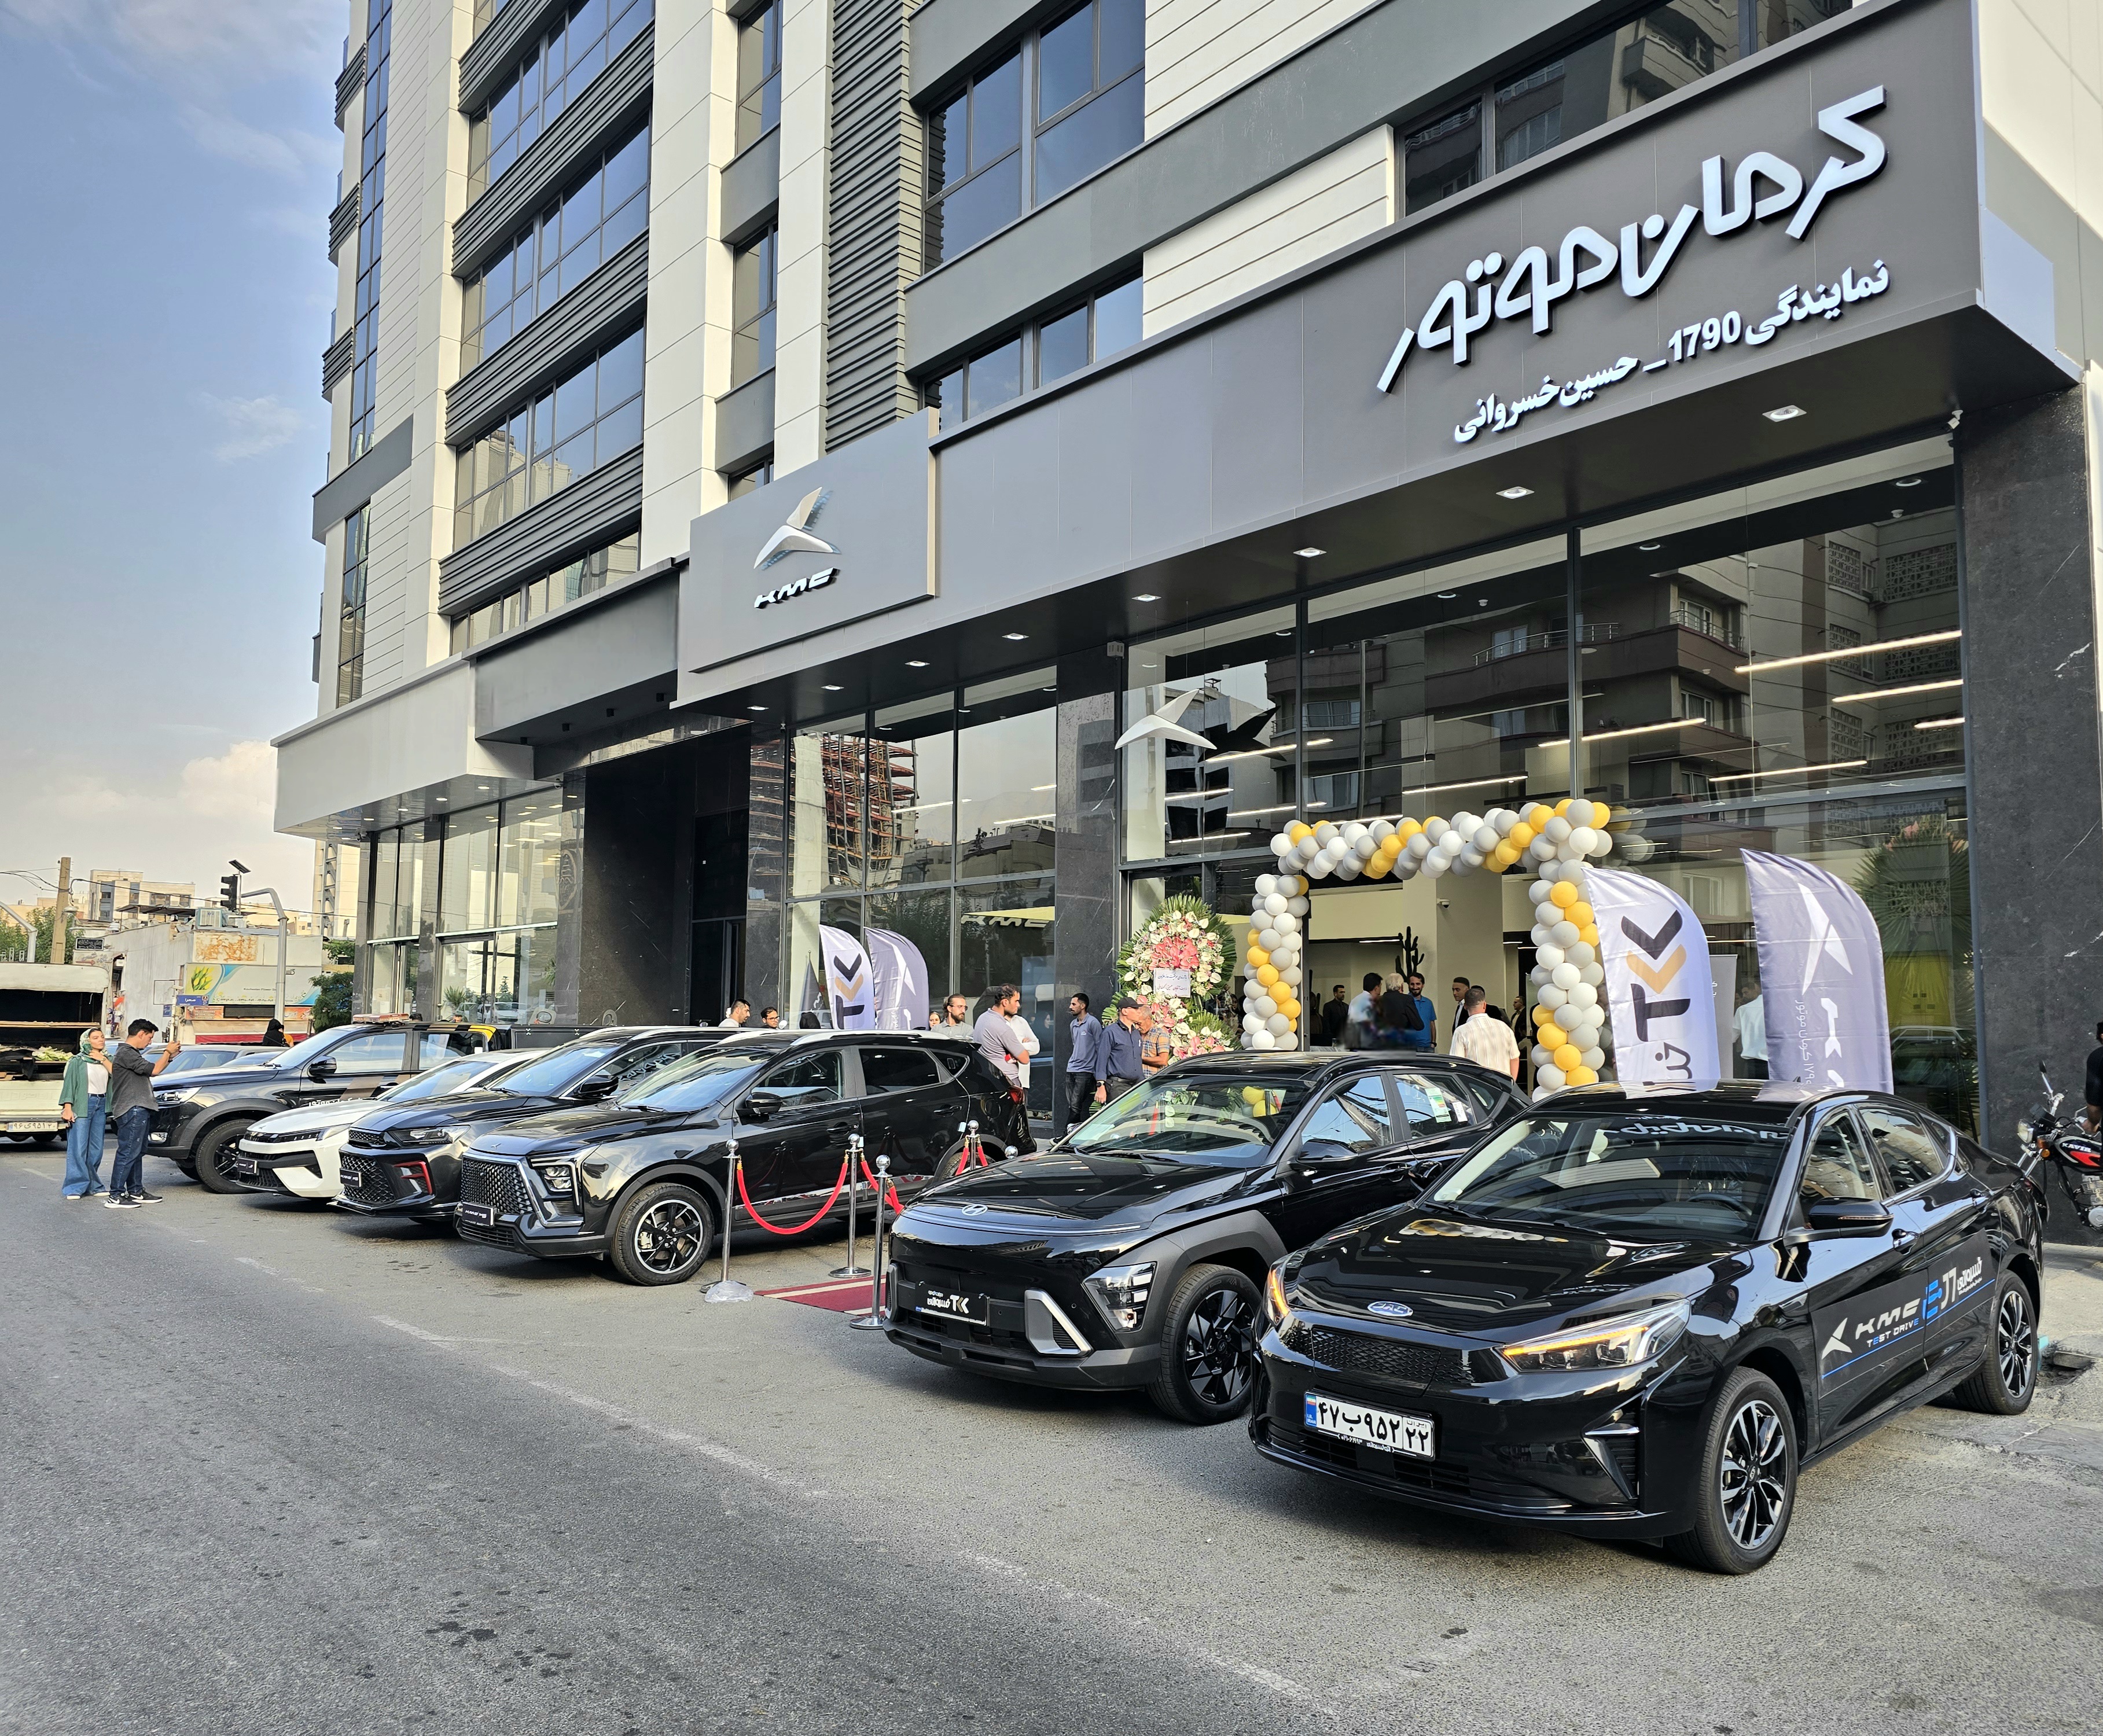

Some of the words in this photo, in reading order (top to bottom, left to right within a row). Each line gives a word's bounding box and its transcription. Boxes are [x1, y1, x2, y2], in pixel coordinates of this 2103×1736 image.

[1621, 84, 1887, 298] کرمان
[1376, 225, 1620, 393] موتور
[1744, 259, 1889, 345] نمایندگی
[1667, 310, 1741, 363] 1790
[1559, 352, 1639, 406] حسین
[1454, 376, 1562, 443] خسروانی
[754, 567, 838, 608] KMC
[1795, 999, 1808, 1028] موتور
[1798, 1029, 1812, 1061] کرمان
[2062, 1142, 2092, 1153] KAVIR
[1855, 1297, 1921, 1340] KMC
[1866, 1330, 1892, 1348] TEST
[1893, 1317, 1920, 1336] DRIVE
[1405, 1426, 1429, 1452] ۲۲
